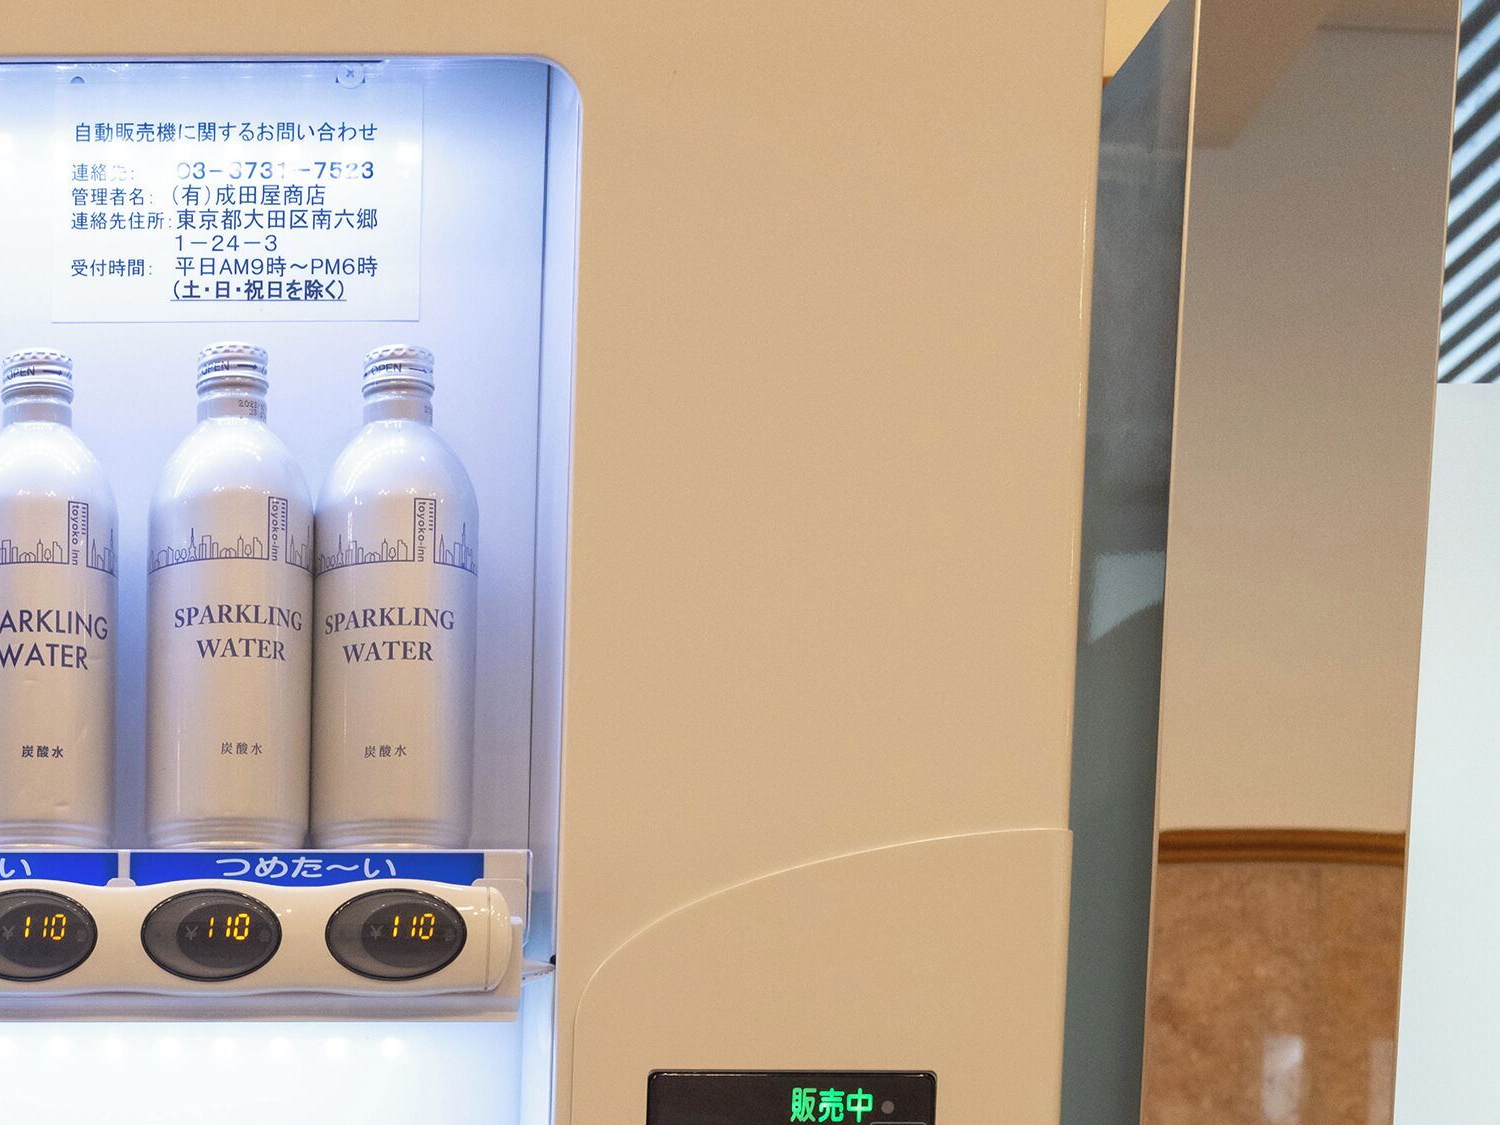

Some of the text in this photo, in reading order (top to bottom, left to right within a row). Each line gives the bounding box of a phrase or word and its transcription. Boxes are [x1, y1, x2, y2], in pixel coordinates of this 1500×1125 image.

[75, 122, 378, 142] 自動販売機に関するお問い合わせ
[176, 208, 378, 230] 東京都大田区南六郷
[174, 604, 302, 631] SPARKLING
[325, 606, 454, 635] SPARKLING
[196, 637, 286, 662] WATER
[343, 640, 433, 664] WATER
[21, 745, 64, 758] 炭酸水
[220, 742, 262, 755] 炭酸水
[364, 745, 407, 758] 炭酸水
[24, 914, 67, 941] 110
[207, 913, 250, 941] 110
[392, 913, 435, 940] 110
[790, 1087, 874, 1123] 販売中
